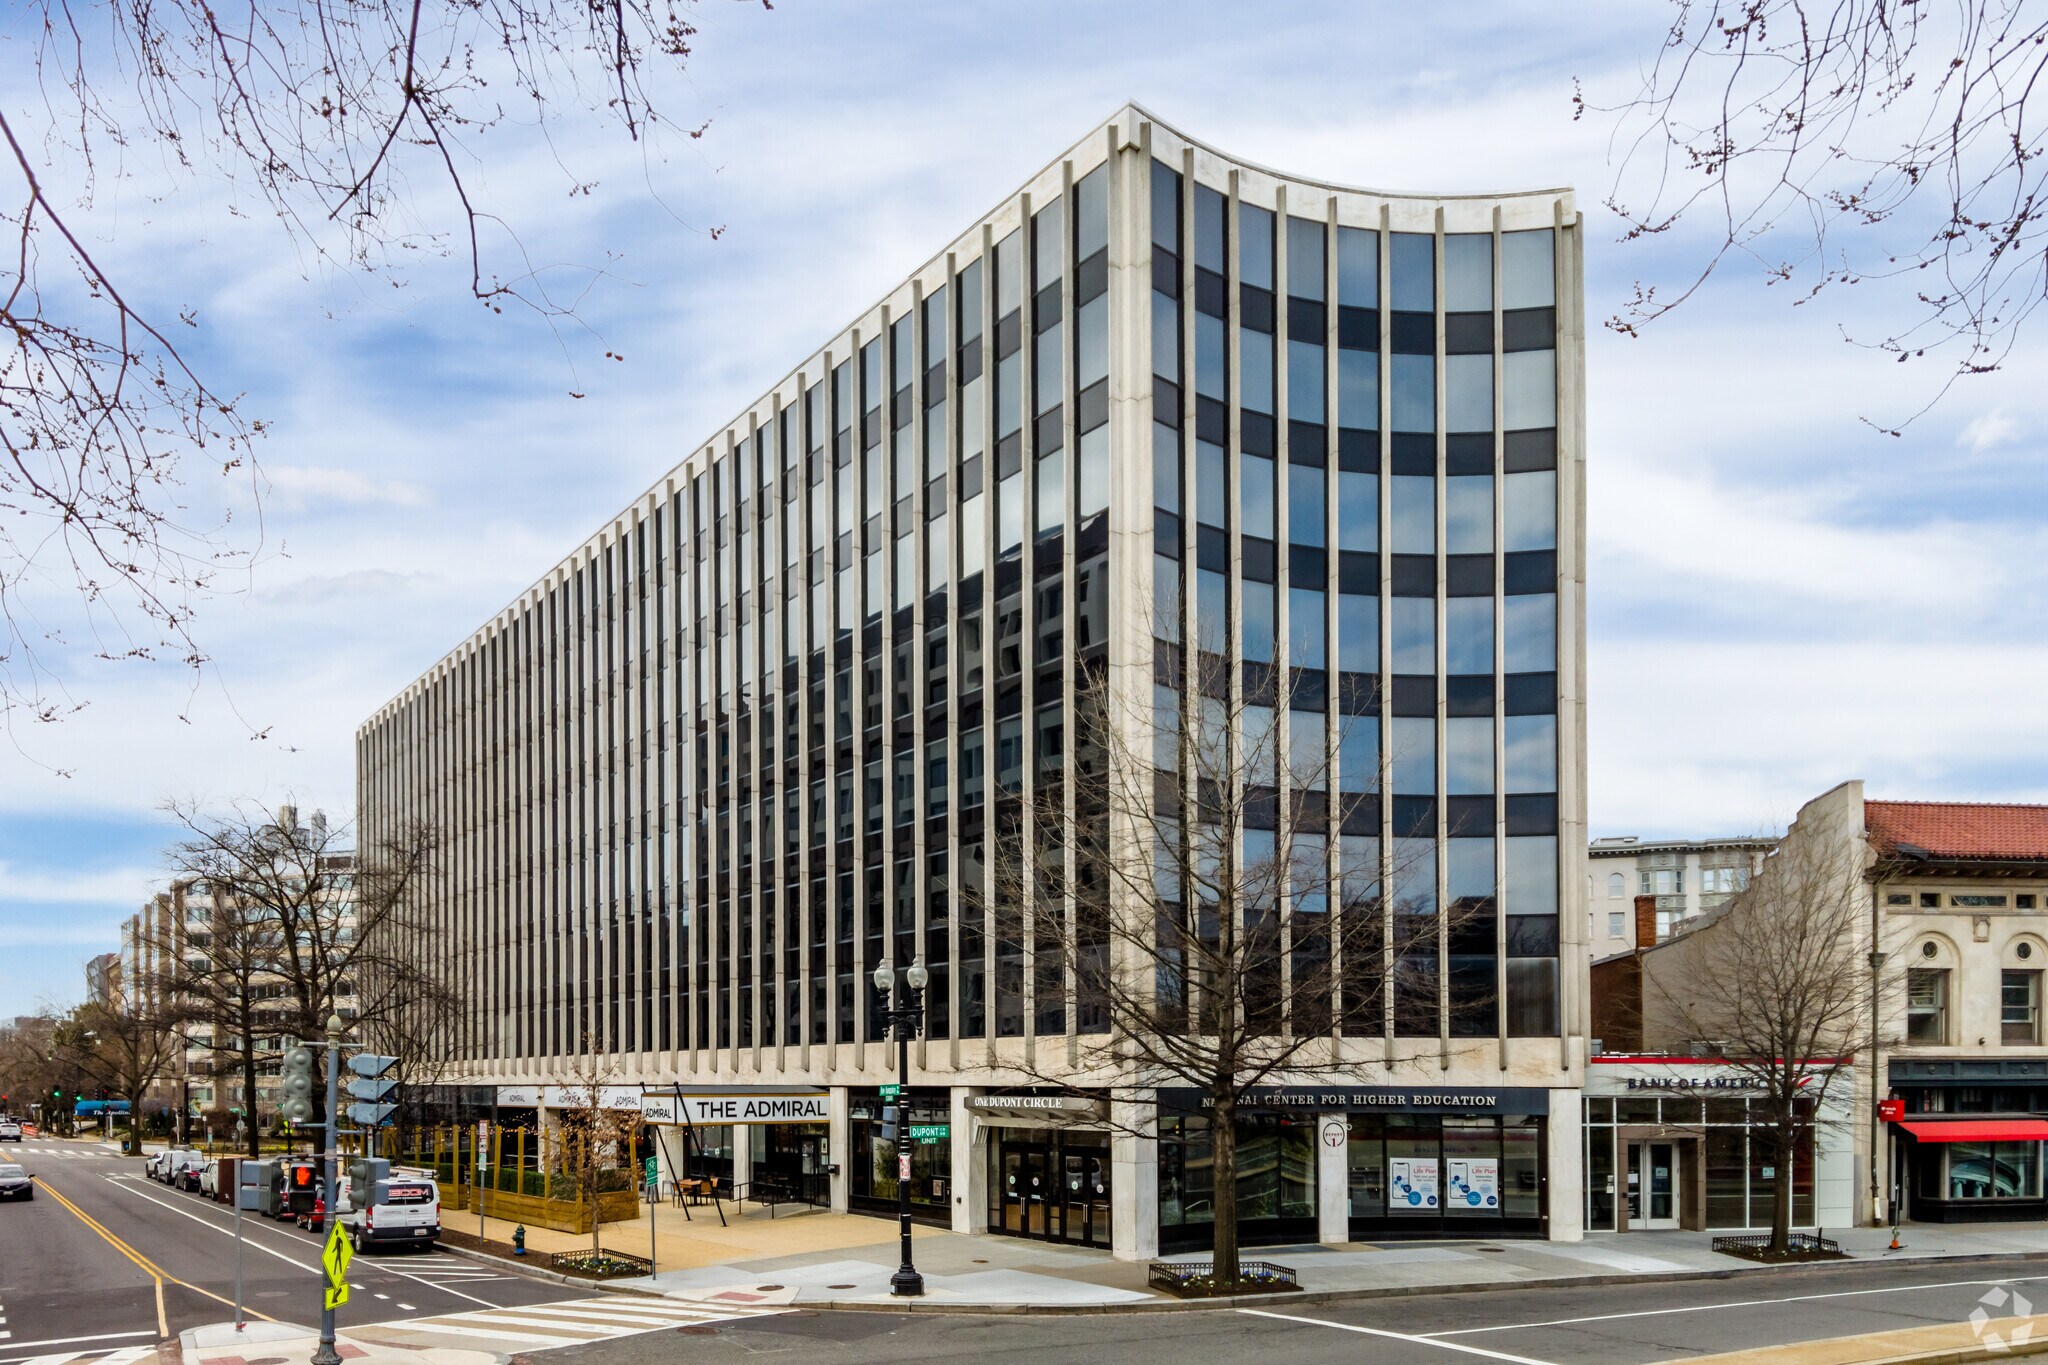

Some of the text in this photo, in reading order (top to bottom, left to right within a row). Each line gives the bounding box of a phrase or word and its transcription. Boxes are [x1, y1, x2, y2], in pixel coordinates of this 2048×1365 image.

[1628, 1078, 1772, 1089] BANK OF AMERIC
[615, 1096, 638, 1106] ADMIRAL
[974, 1096, 1063, 1108] ONE DUPONT CIRCLE
[1264, 1094, 1315, 1105] CENTER
[1321, 1094, 1347, 1105] FOR
[1353, 1094, 1406, 1105] HIGHER
[1413, 1095, 1496, 1106] EDUCATION
[646, 1108, 672, 1119] ADMIRAL
[697, 1100, 827, 1118] THE ADMIRAL
[912, 1127, 939, 1137] DUPONT
[1660, 1128, 1666, 1136] 3
[1332, 1138, 1336, 1147] 1
